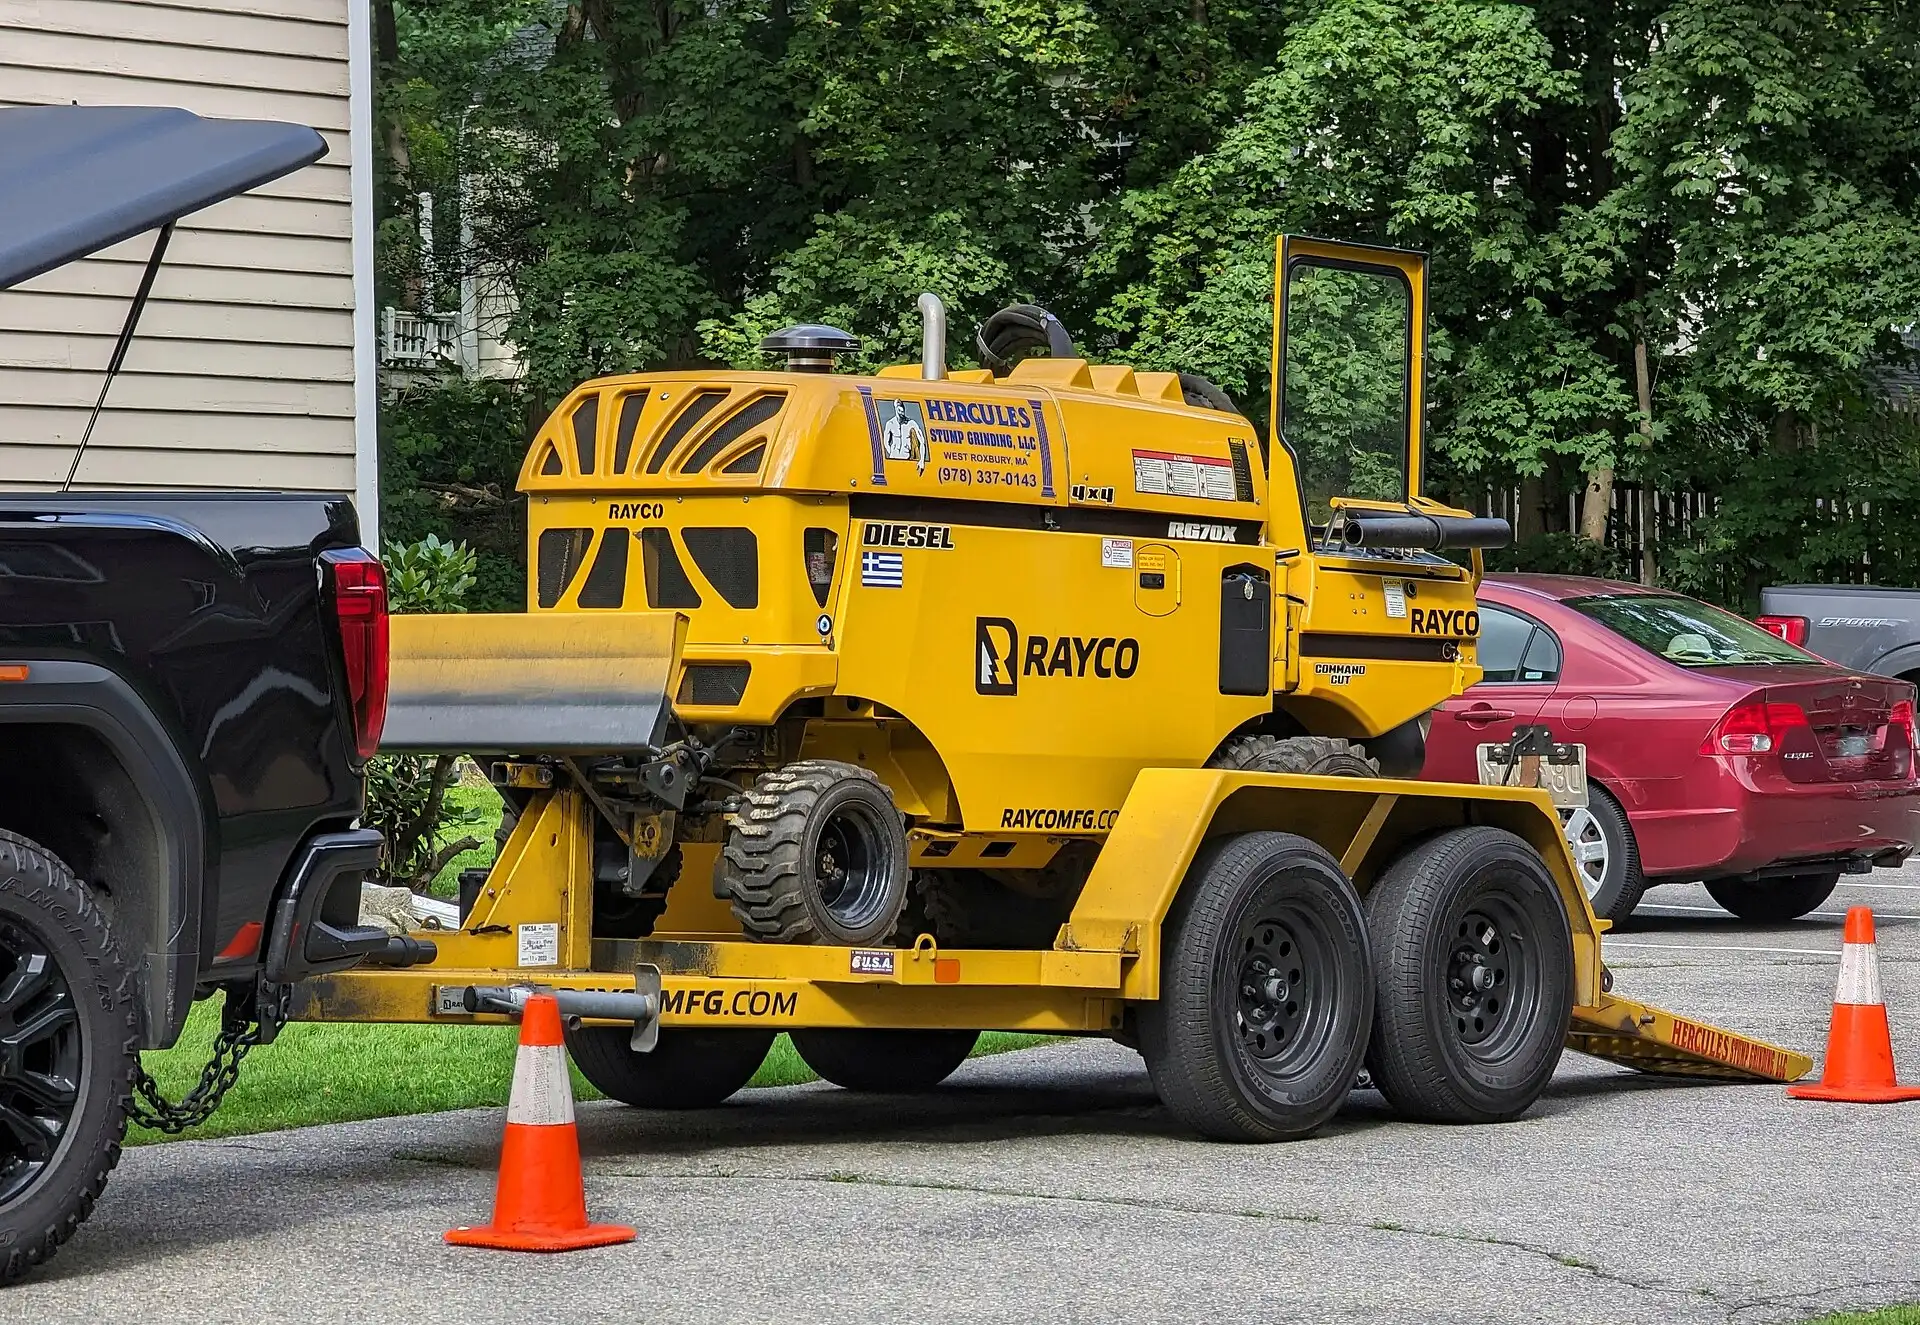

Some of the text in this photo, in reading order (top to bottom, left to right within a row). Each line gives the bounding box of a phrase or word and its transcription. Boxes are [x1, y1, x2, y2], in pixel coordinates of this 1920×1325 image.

[925, 399, 1031, 428] HERCULES
[930, 428, 1036, 450] STUMP GRINDING, LLC
[943, 451, 1028, 466] WEST ROXBURY, MA
[938, 467, 1037, 487] (978) 337-0143
[1071, 484, 1114, 503] 4x4
[609, 503, 664, 519] RAYCO
[863, 523, 954, 549] DIESEL
[1168, 521, 1238, 542] RG70X
[1411, 608, 1480, 636] RAYCO
[1817, 617, 1888, 628] SPORT
[1023, 636, 1140, 679] RAYCO
[1315, 664, 1366, 675] COMMAND
[1331, 675, 1351, 685] CUT
[1001, 808, 1120, 829] RAYCOMFG.CO
[862, 956, 893, 969] U.S.A.
[1671, 1019, 1729, 1061] HERCULES
